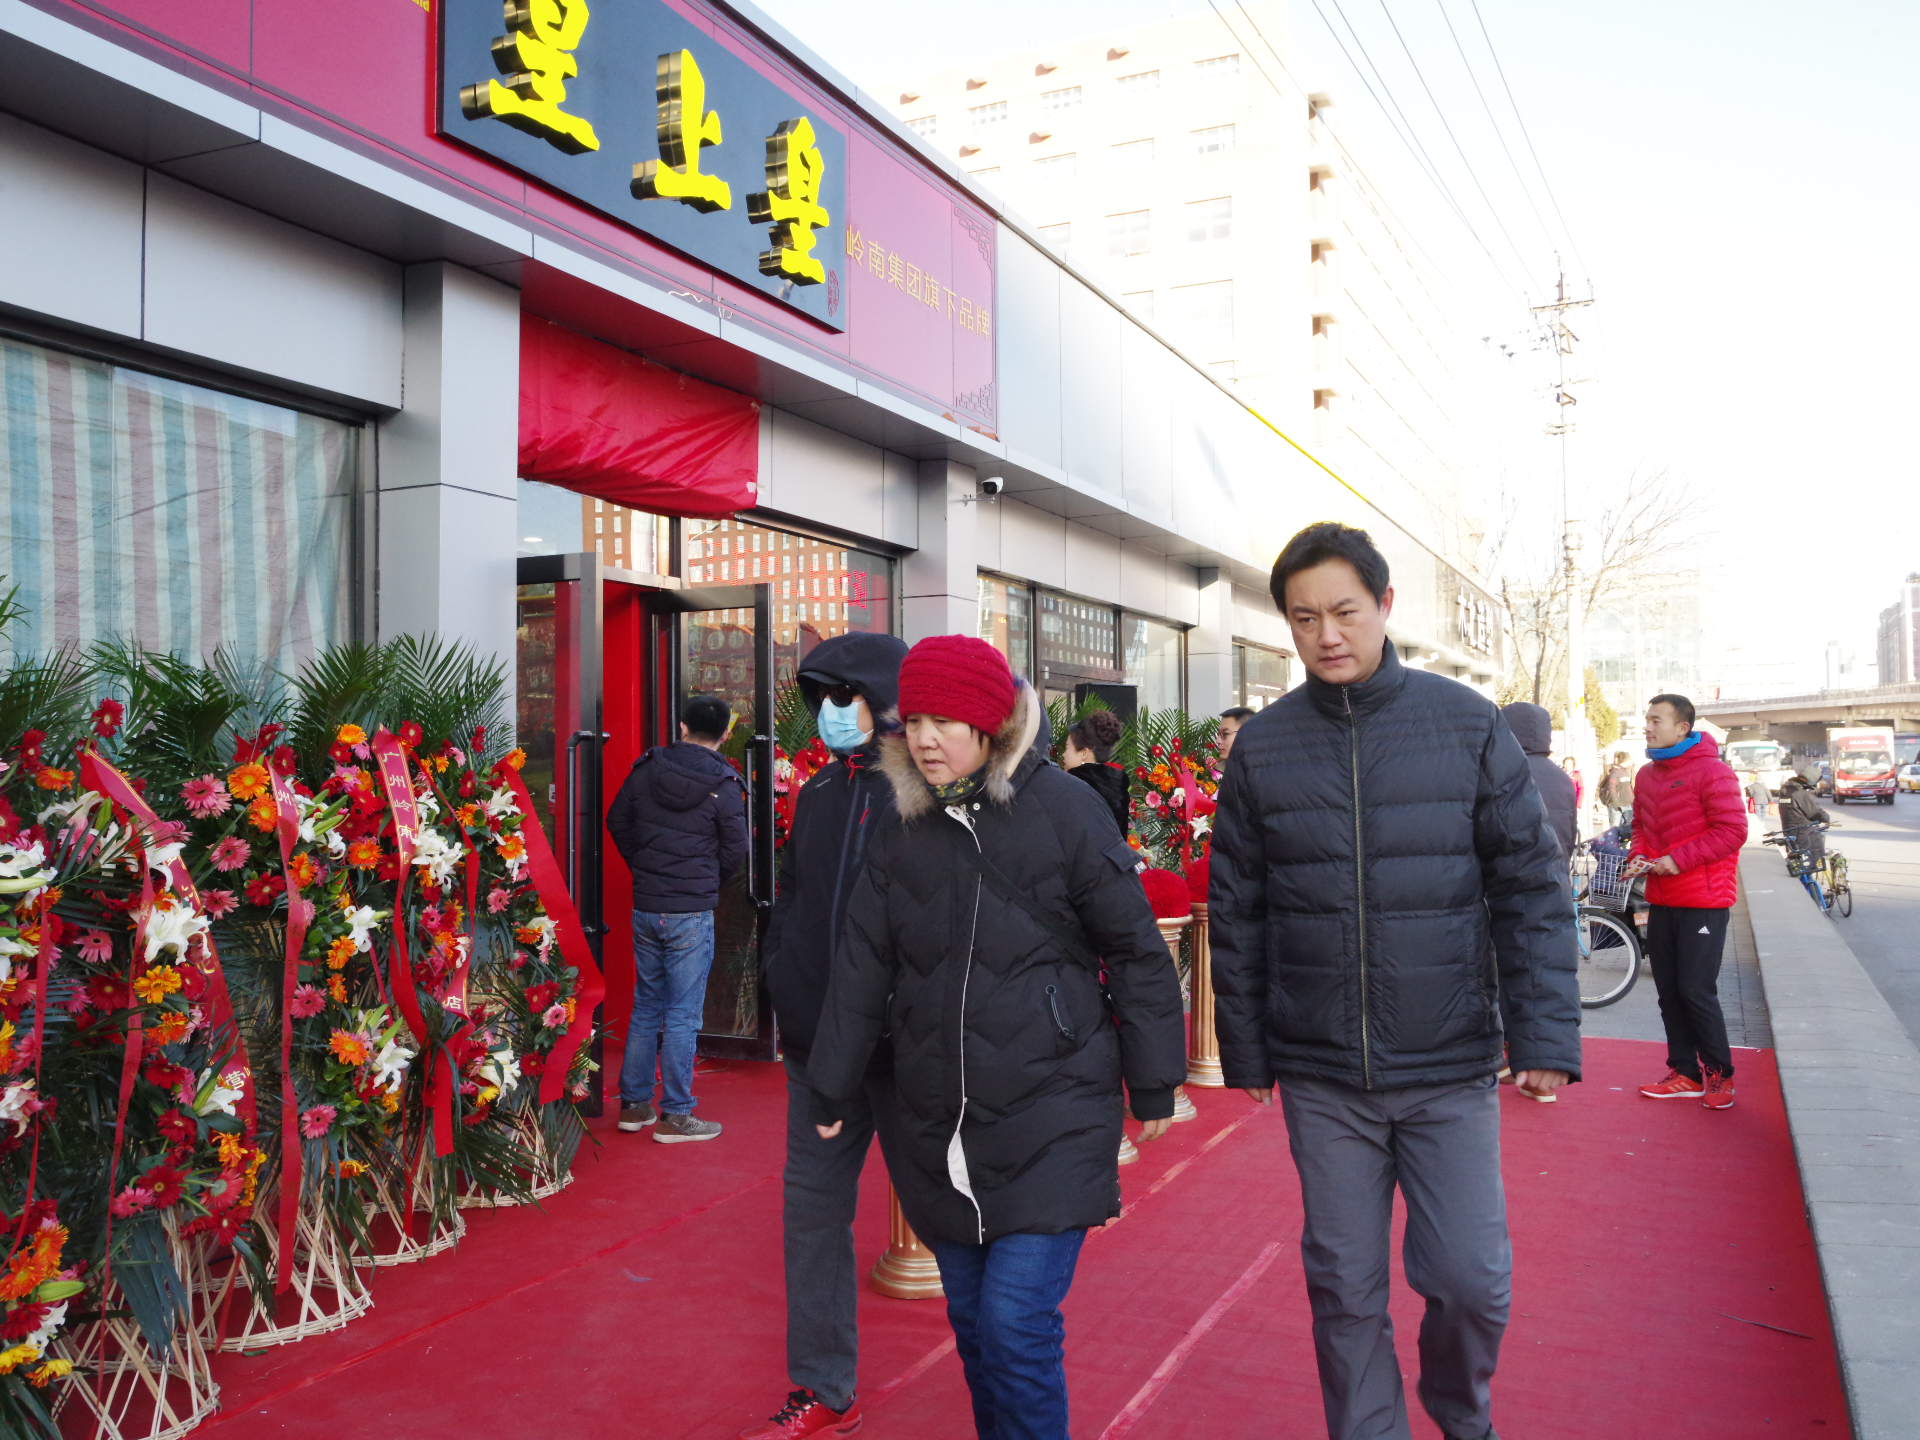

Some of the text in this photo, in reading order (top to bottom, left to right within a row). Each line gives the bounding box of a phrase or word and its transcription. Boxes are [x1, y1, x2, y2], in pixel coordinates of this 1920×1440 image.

[846, 224, 991, 338] 岭南集团旗下品牌
